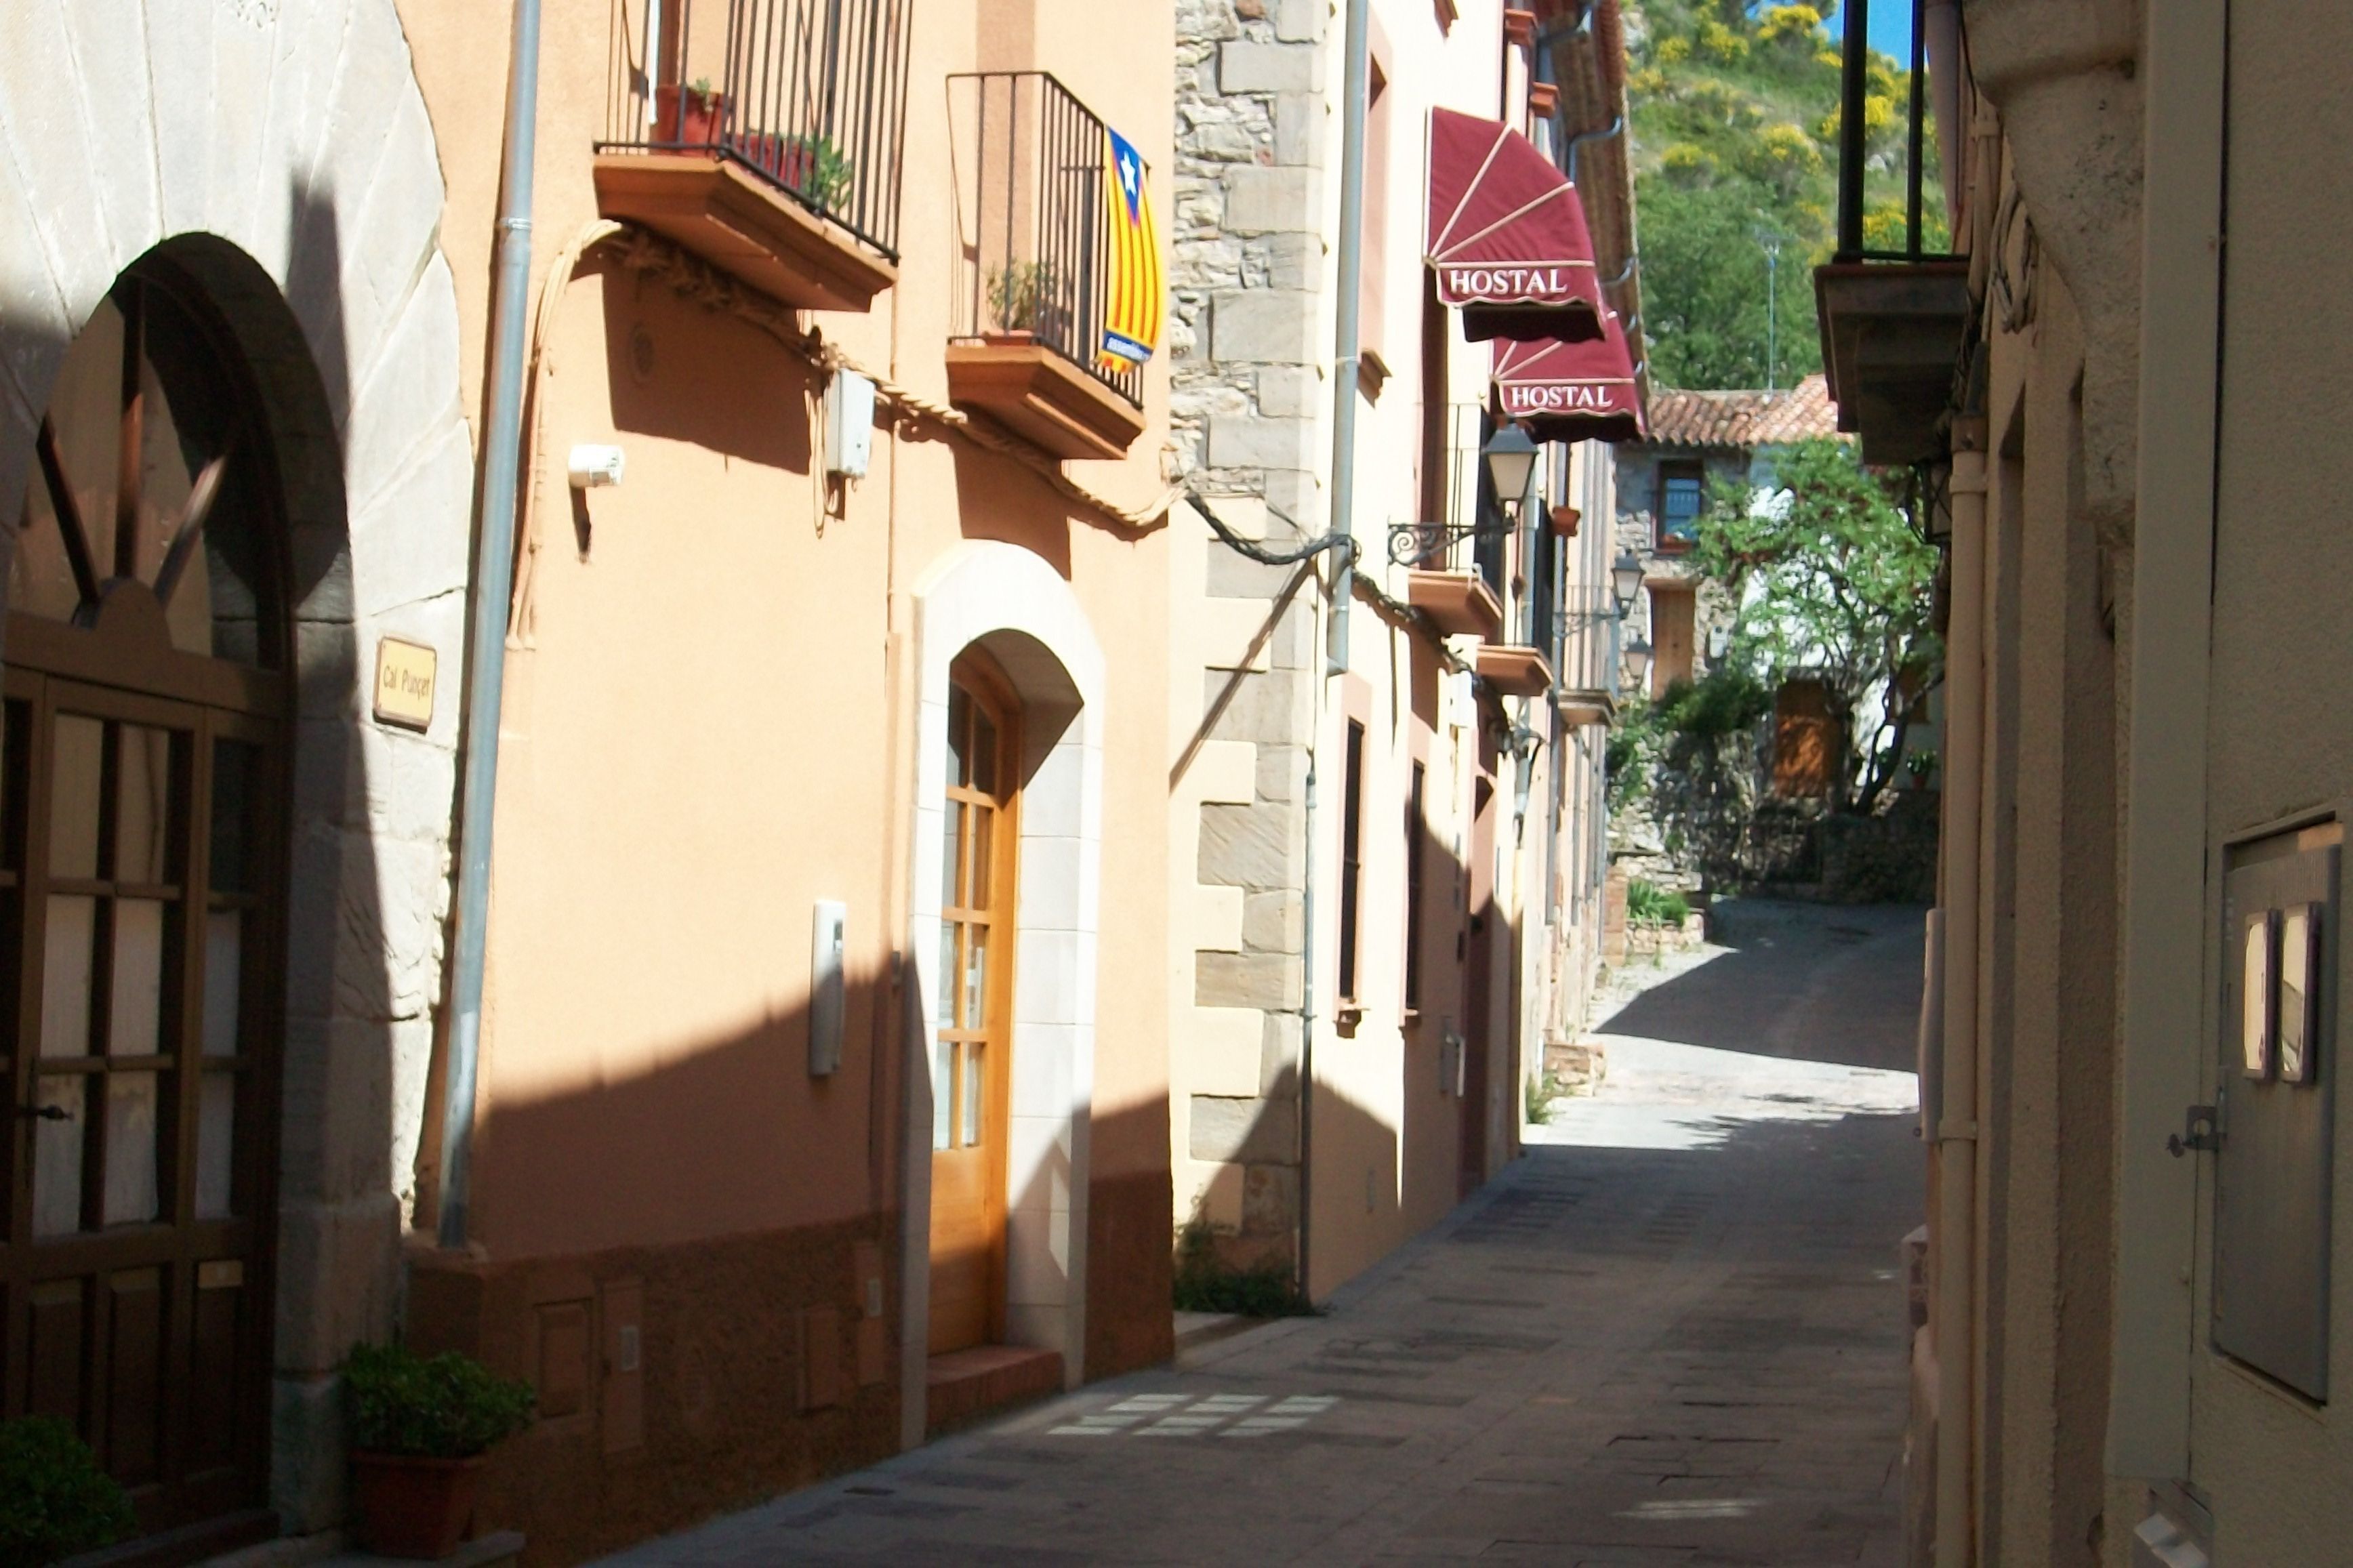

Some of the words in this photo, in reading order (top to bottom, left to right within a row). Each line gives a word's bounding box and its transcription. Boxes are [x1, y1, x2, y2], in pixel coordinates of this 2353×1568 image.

[1449, 269, 1568, 295] HOSTAL
[1511, 386, 1614, 408] HOSTAL
[383, 665, 397, 690] Cal
